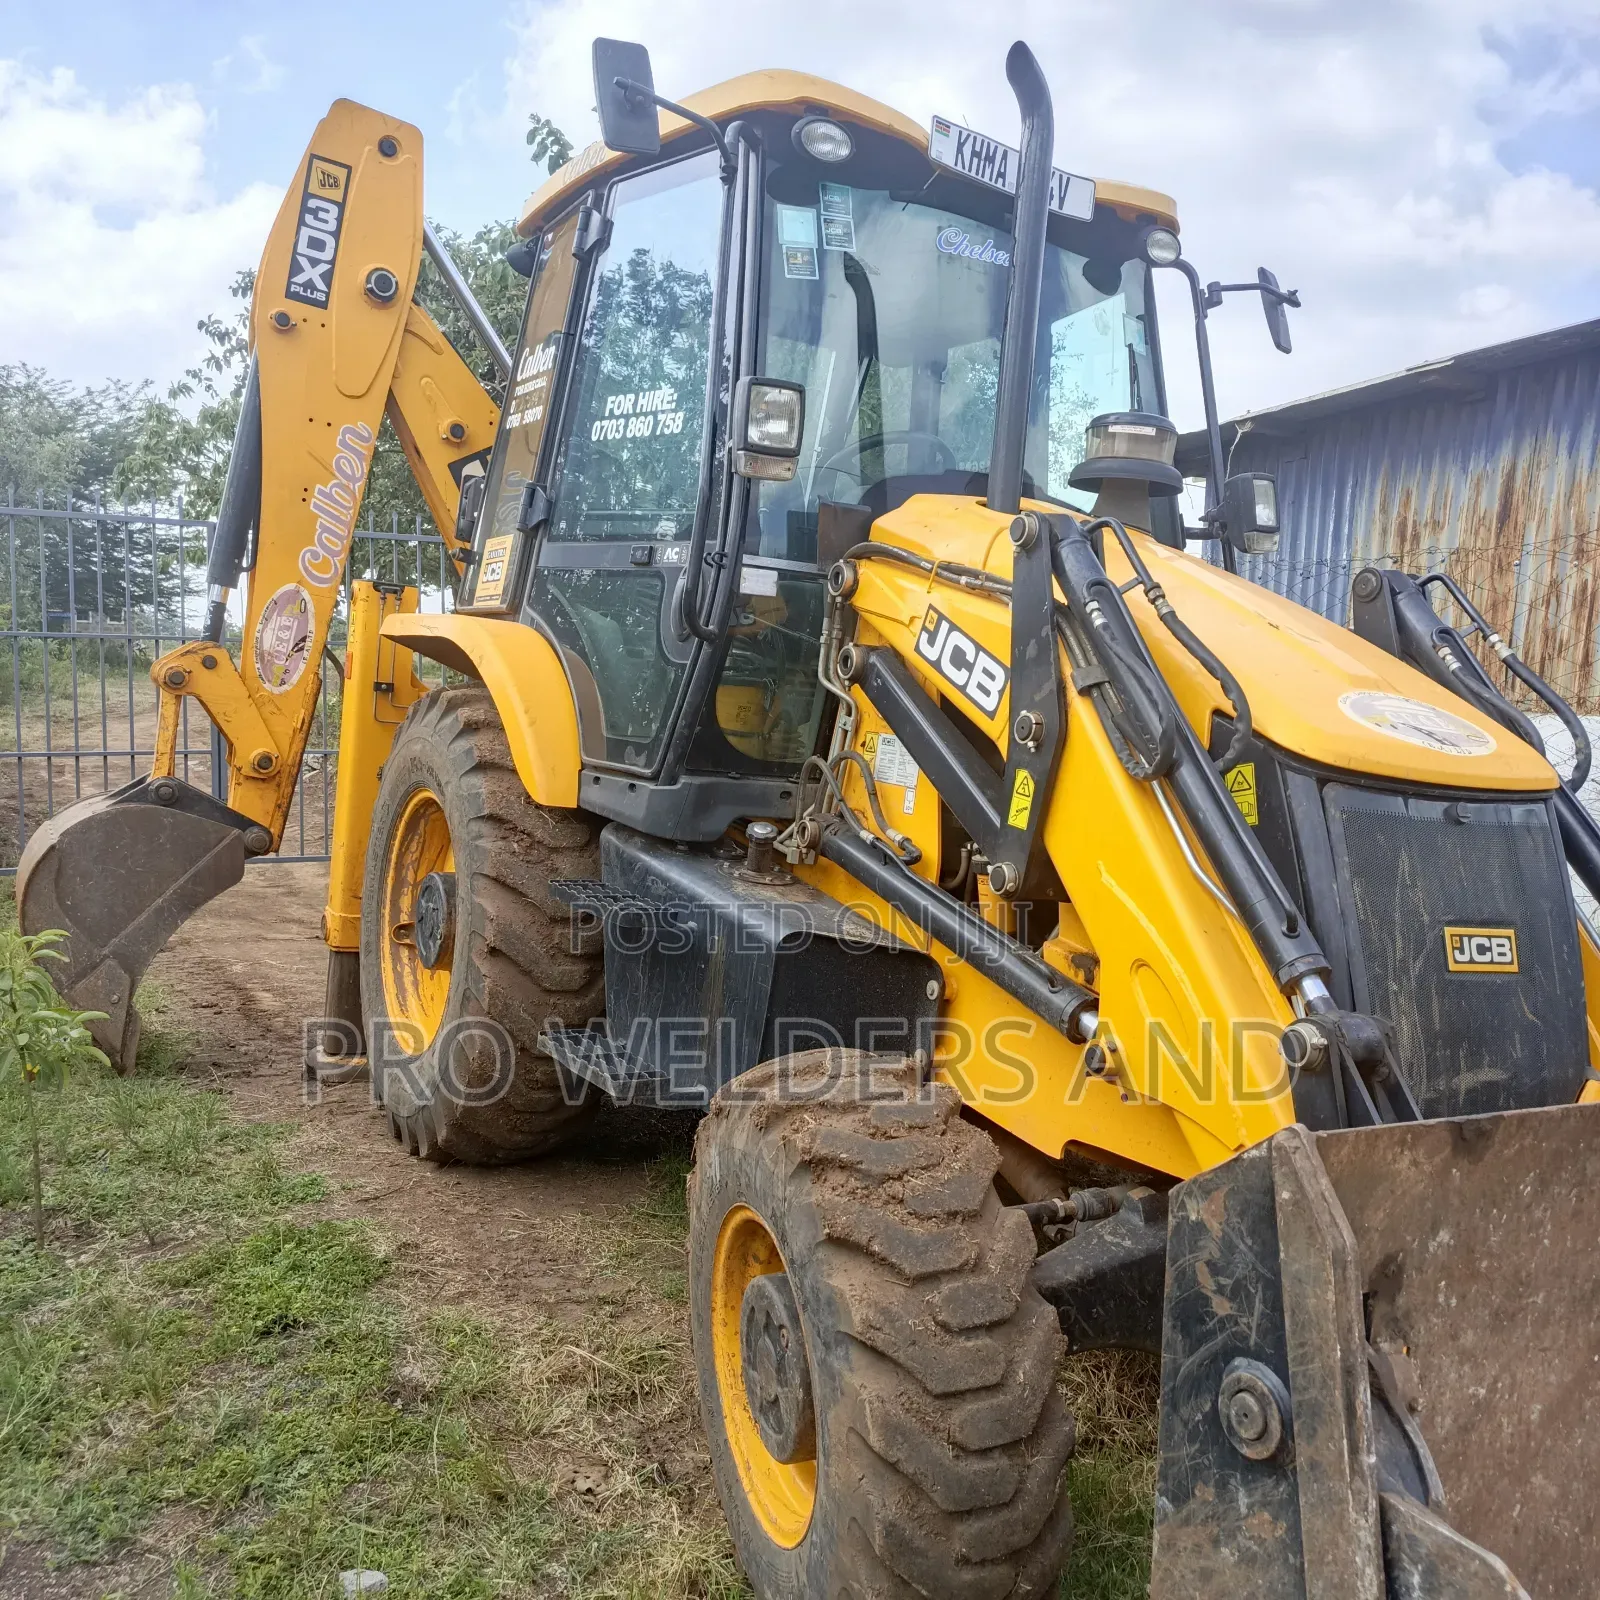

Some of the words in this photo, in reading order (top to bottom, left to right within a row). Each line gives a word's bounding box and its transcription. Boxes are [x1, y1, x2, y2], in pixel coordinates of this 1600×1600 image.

[954, 130, 1009, 188] KHMA
[320, 170, 341, 188] JCB
[290, 198, 339, 292] 3DX
[290, 284, 327, 301] PLUS
[517, 343, 555, 381] Calben
[604, 393, 635, 416] FOR
[636, 388, 678, 413] HIRE:
[591, 418, 625, 441] 0703
[626, 415, 653, 438] 860
[656, 411, 684, 435] 758
[298, 421, 374, 587] Calben
[663, 547, 680, 559] AC
[482, 562, 503, 582] JCB
[919, 620, 1006, 711] JCB
[1453, 936, 1512, 963] JCB
